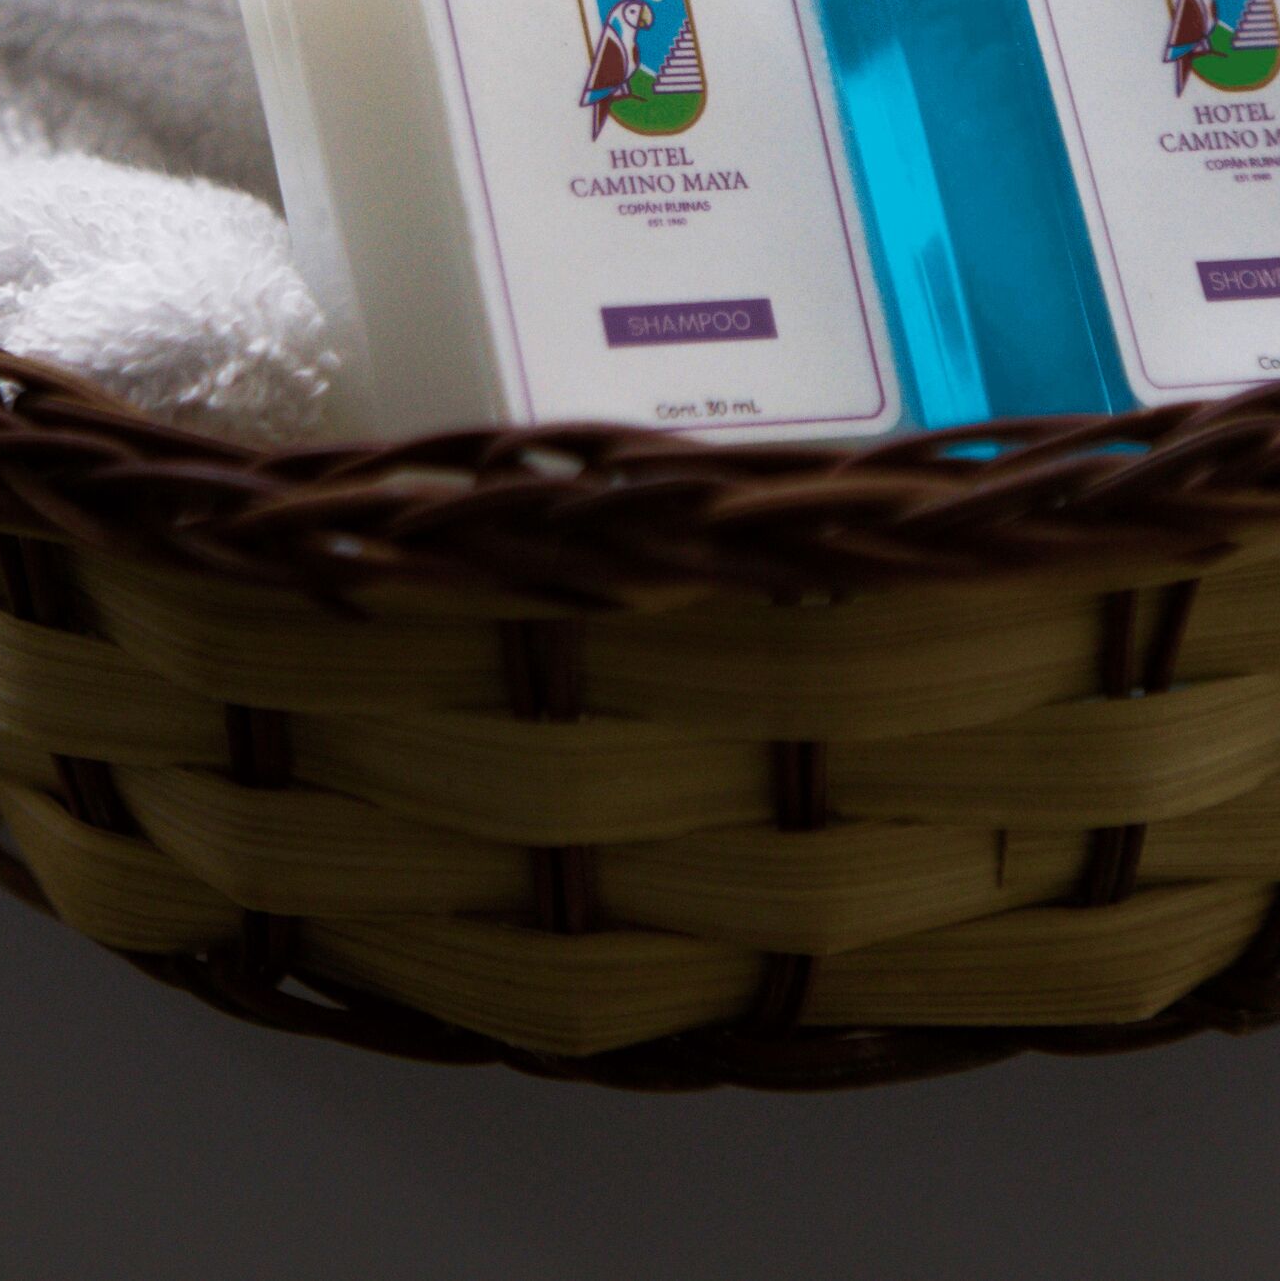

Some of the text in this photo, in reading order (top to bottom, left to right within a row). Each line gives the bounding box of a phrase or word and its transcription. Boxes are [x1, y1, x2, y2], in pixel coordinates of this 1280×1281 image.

[1194, 103, 1275, 125] HOTEL
[1159, 130, 1258, 153] CAMINO
[610, 147, 694, 169] HOTEL
[570, 171, 749, 198] CAMINO MAYA
[618, 200, 711, 215] COPÁN RUINAS
[627, 310, 751, 336] SHAMPOO
[706, 400, 727, 416] 30
